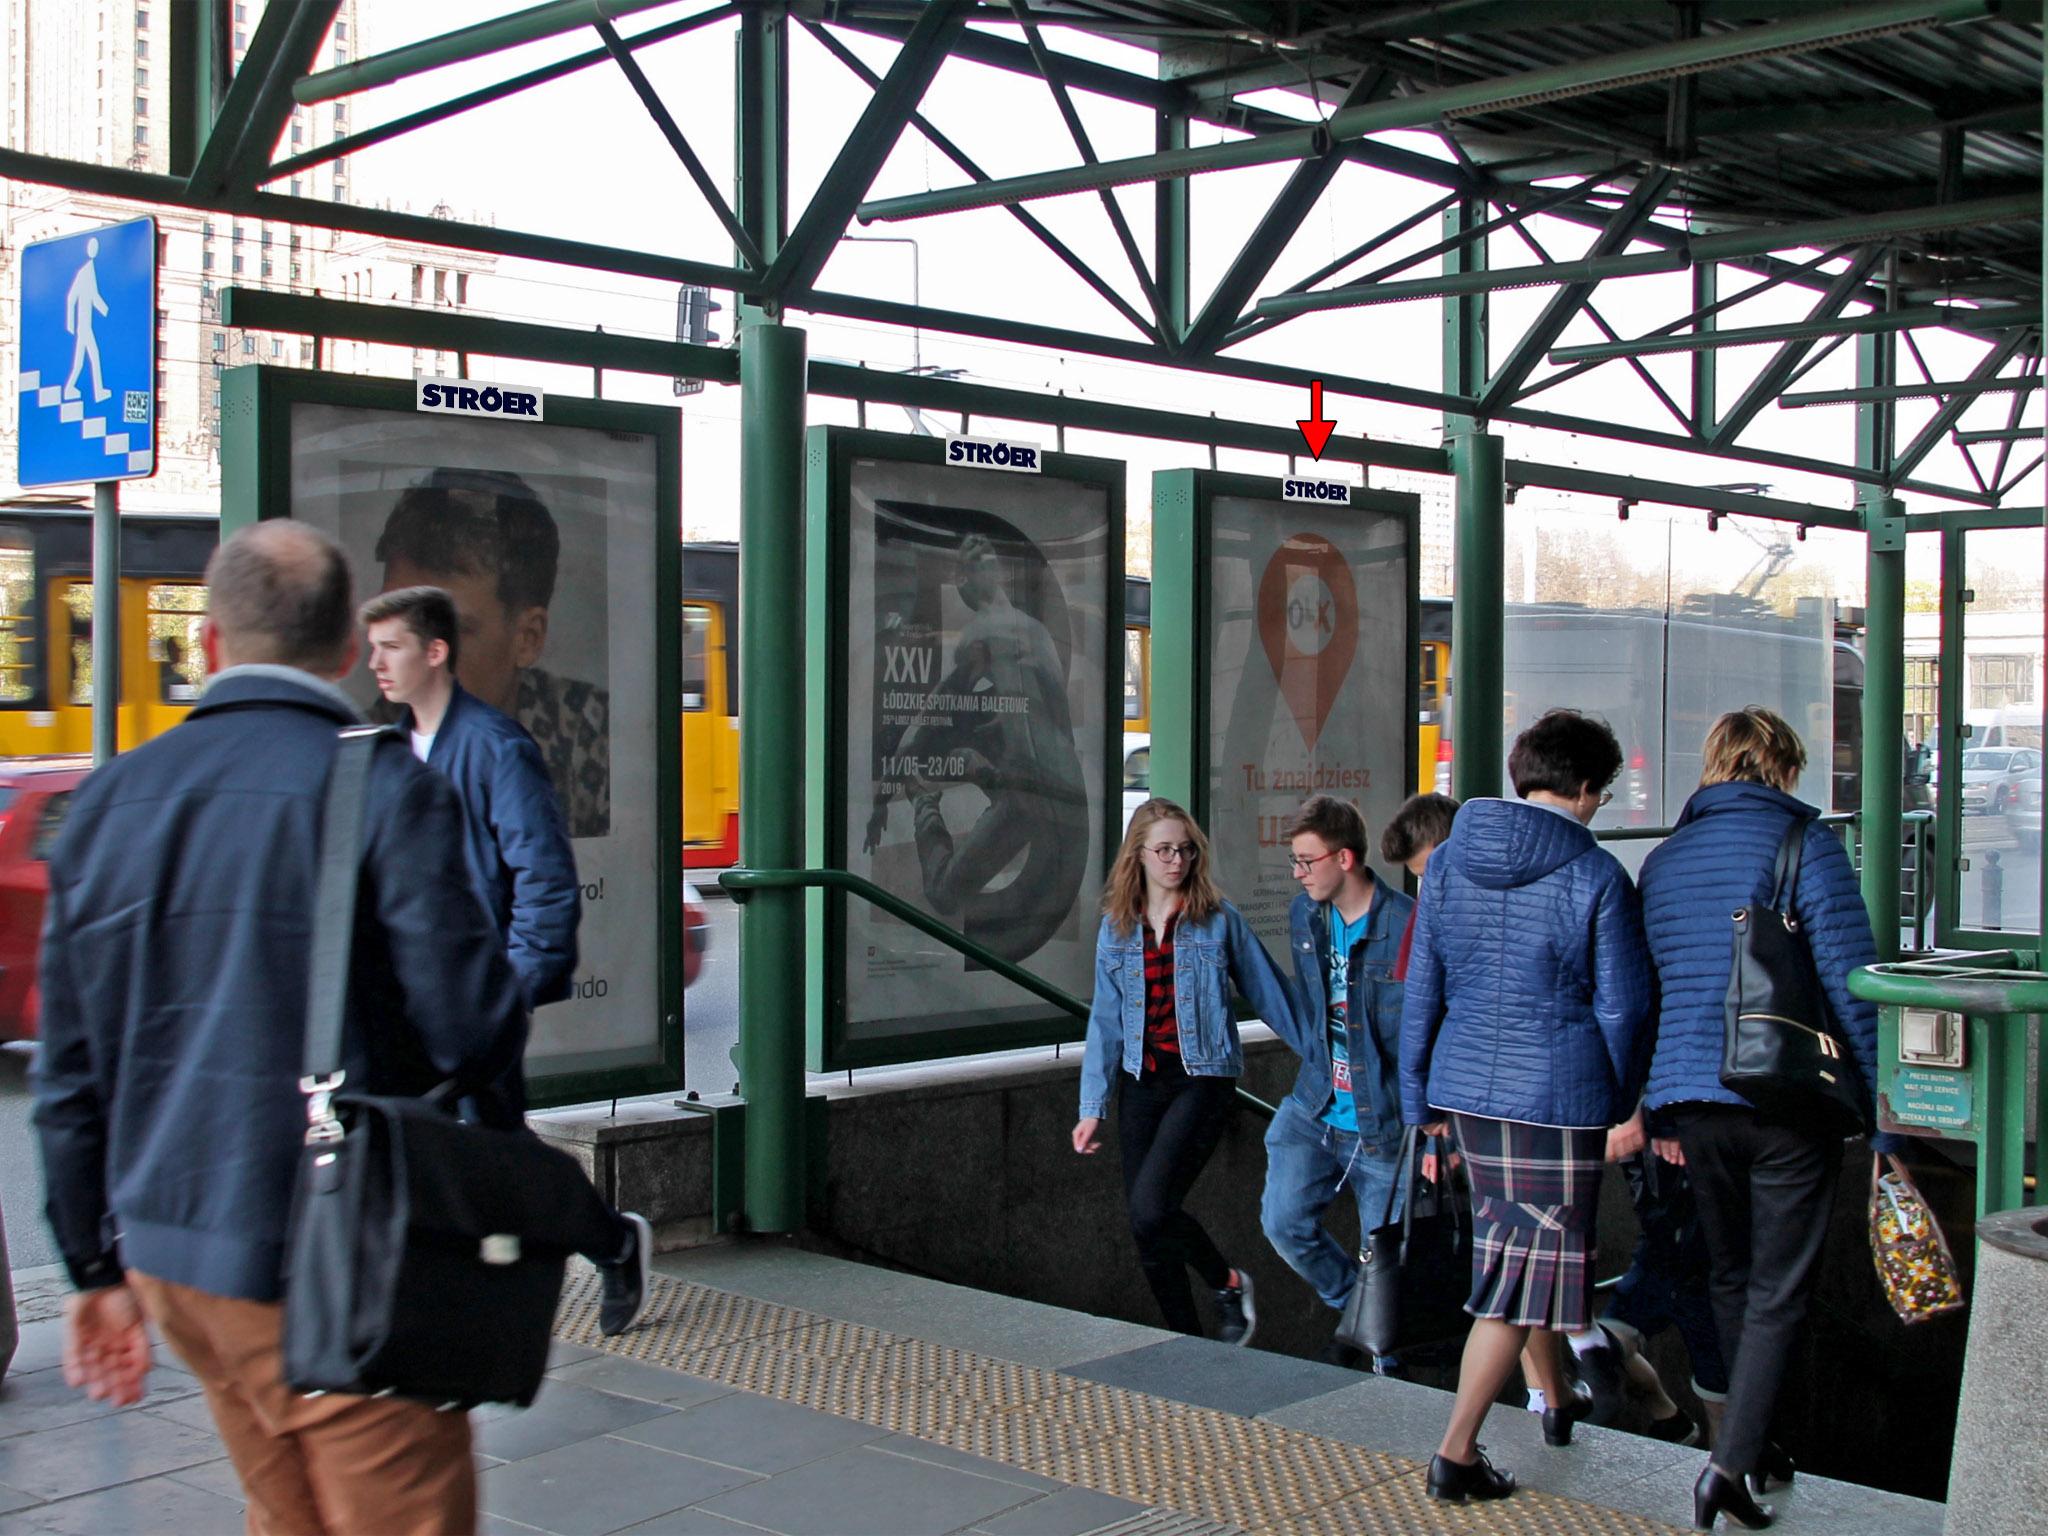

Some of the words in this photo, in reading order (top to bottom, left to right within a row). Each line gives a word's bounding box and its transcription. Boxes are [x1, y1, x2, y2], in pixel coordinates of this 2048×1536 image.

[422, 383, 538, 416] STRÖER
[949, 440, 1037, 469] STRÖER
[1285, 479, 1348, 502] STRÖER
[883, 645, 932, 684] XXV
[883, 689, 926, 711] ŁÓDZKIE
[927, 694, 979, 713] SPOTKANIA
[981, 696, 1030, 714] BALETOWE
[1243, 763, 1266, 792] Tu
[1273, 762, 1371, 796] znajdziesz
[1934, 1085, 1960, 1095] SERVICE
